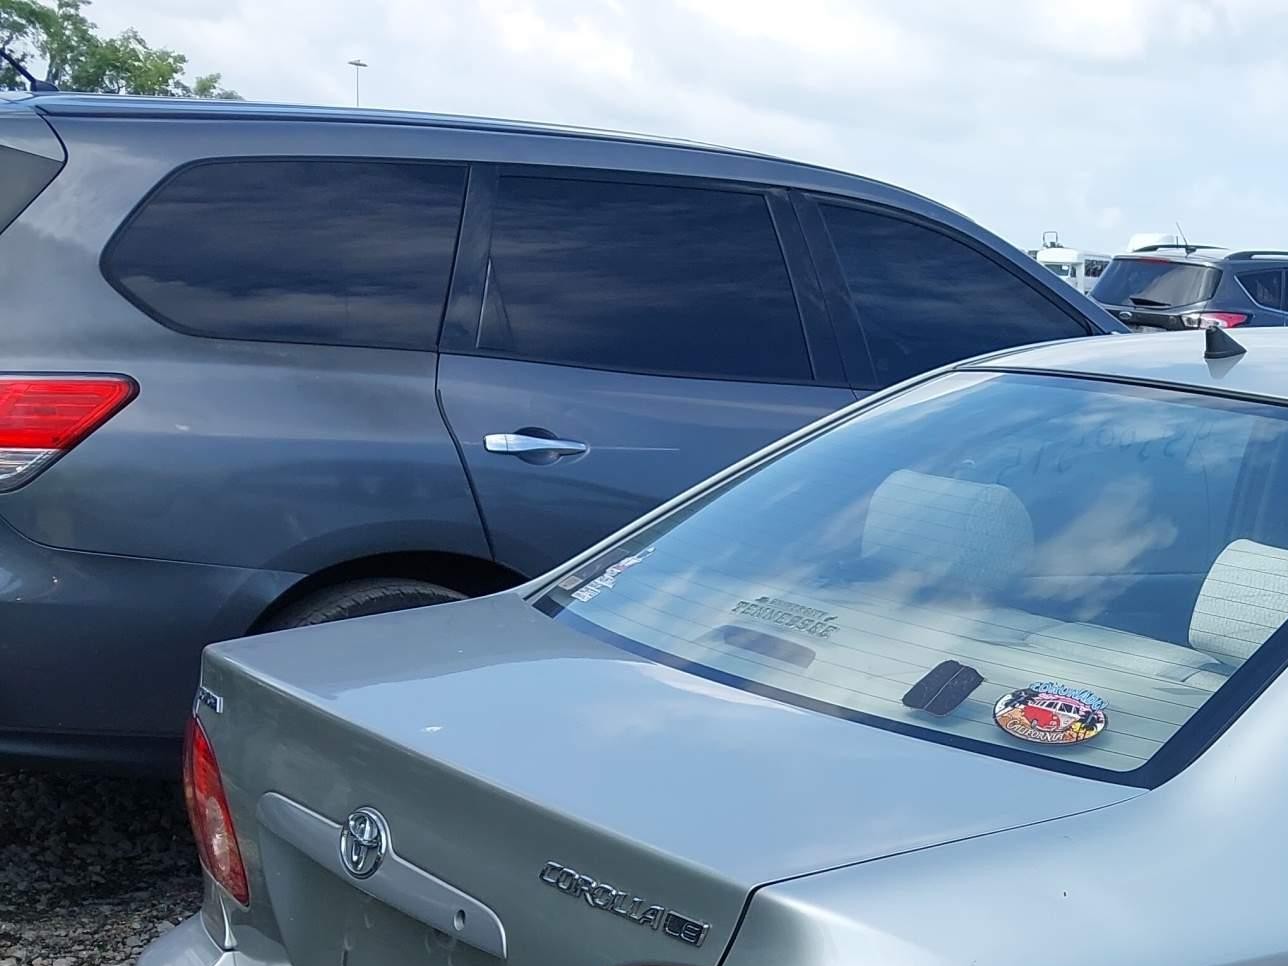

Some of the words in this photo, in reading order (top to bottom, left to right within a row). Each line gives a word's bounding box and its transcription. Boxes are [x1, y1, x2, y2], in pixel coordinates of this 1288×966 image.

[1006, 719, 1065, 742] CALIFORNIA
[539, 861, 664, 931] COROLLA
[664, 911, 711, 948] LE
